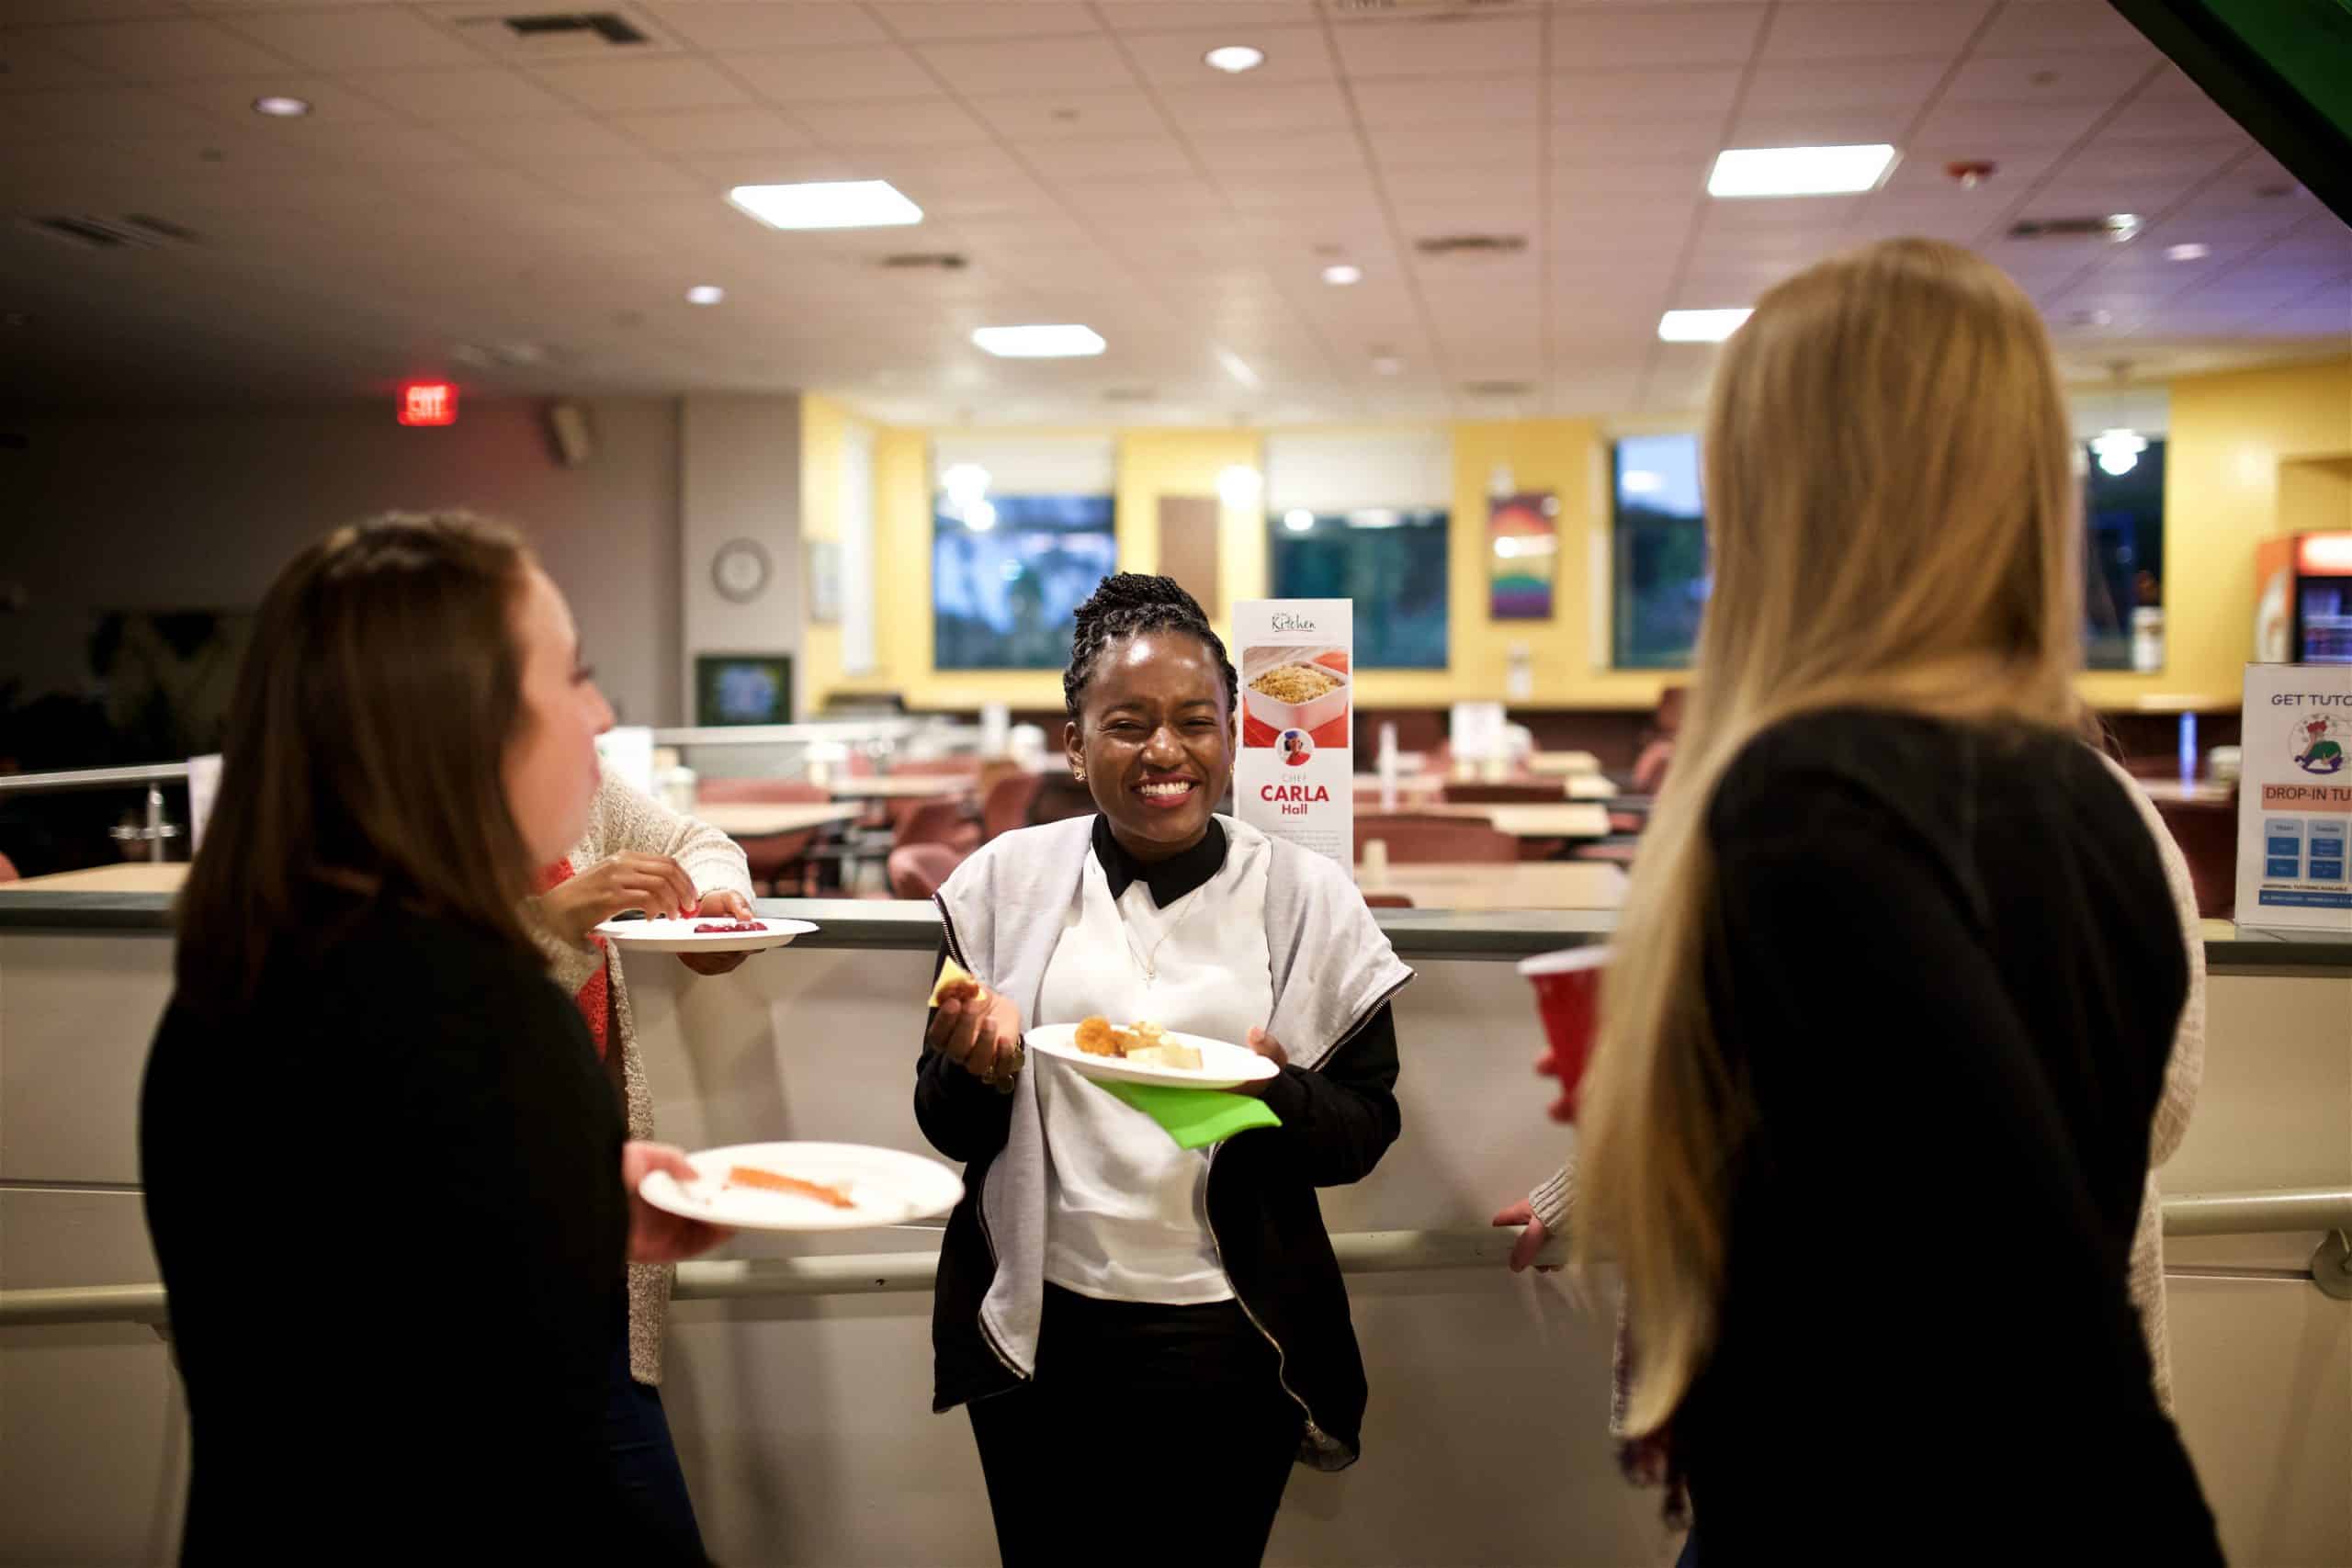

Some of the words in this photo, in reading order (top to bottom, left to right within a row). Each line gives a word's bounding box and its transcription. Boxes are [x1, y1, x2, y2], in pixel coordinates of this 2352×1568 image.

[1272, 614, 1317, 631] Kitchen
[2271, 694, 2305, 706] GET
[1261, 784, 1330, 802] CARLA
[2266, 786, 2327, 801] DROP-IN
[1282, 804, 1308, 815] Hall
